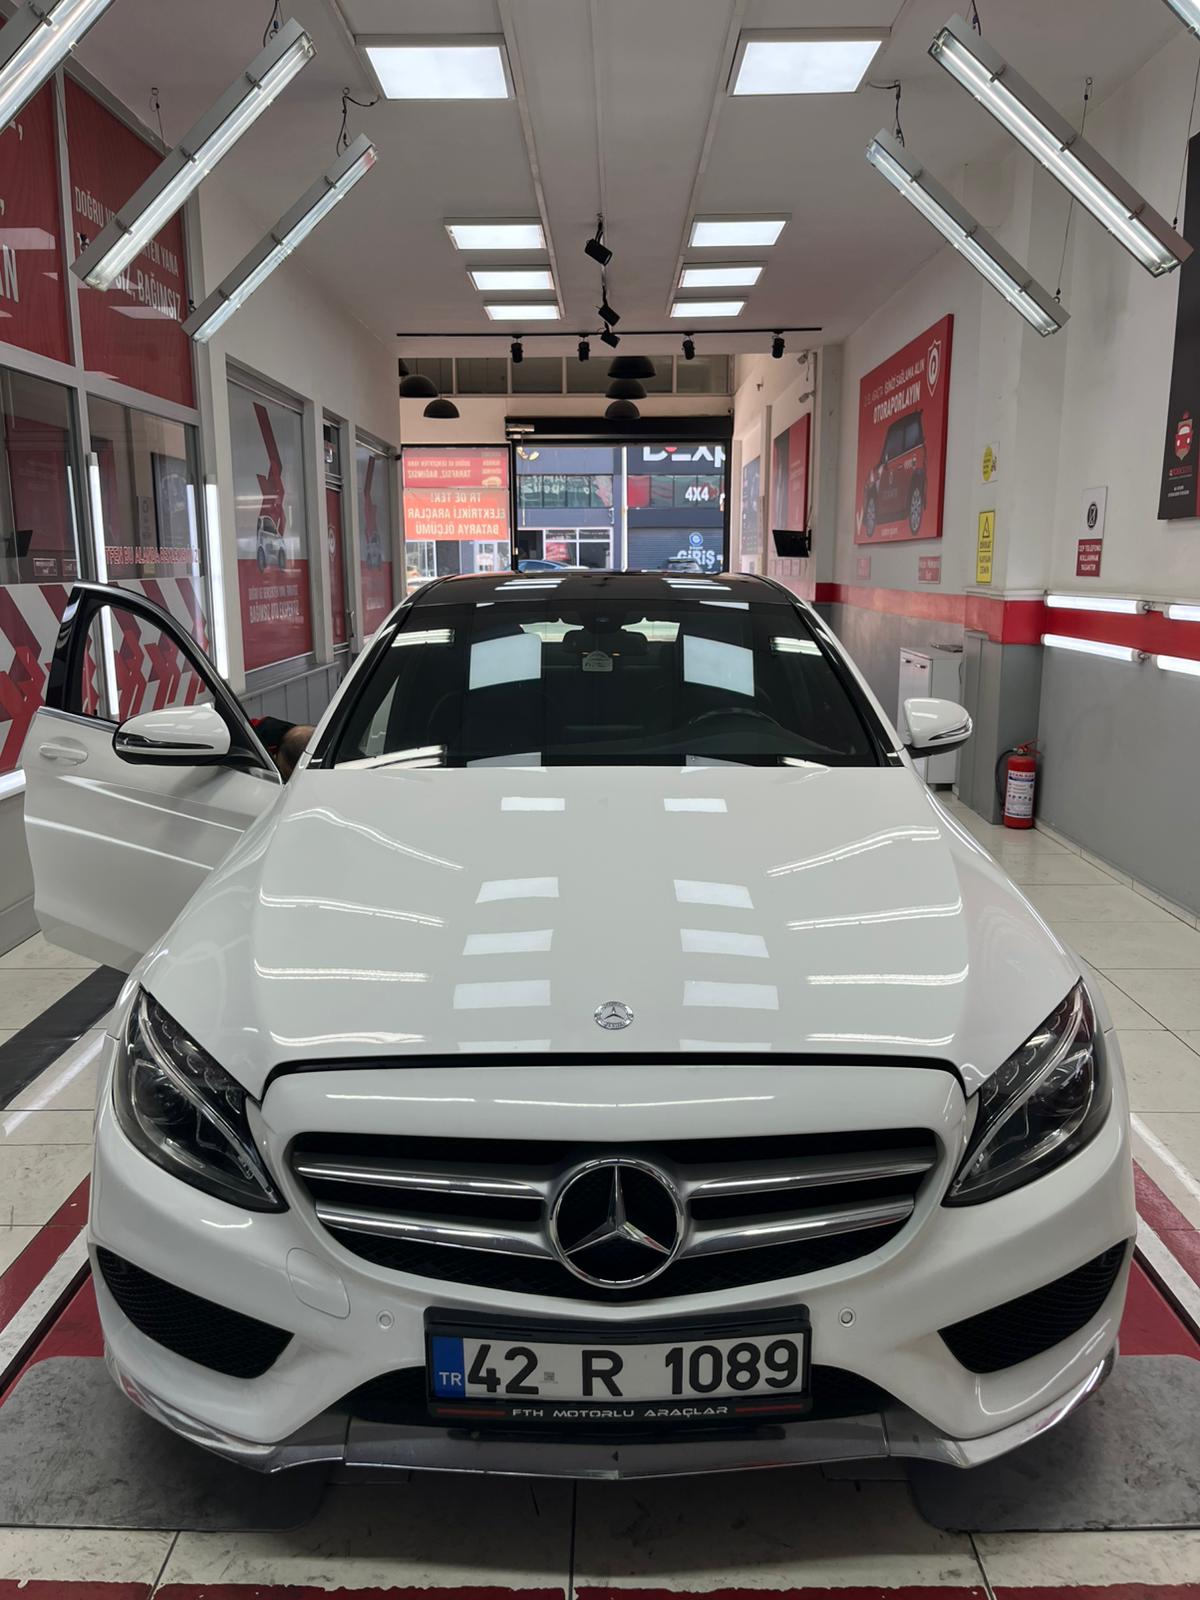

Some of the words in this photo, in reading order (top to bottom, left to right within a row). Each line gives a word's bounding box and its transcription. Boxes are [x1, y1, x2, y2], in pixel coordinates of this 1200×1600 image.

[75, 186, 104, 228] DOĞRU
[136, 269, 182, 323] BAĞIMSIZ
[685, 486, 709, 502] 4X4
[439, 1371, 462, 1387] TR
[467, 1344, 539, 1395] 42
[581, 1350, 624, 1397] R
[665, 1339, 799, 1396] 1089
[512, 1408, 544, 1417] FTH
[553, 1409, 634, 1418] MOTORLU
[644, 1406, 728, 1418] ARAÇLAR
